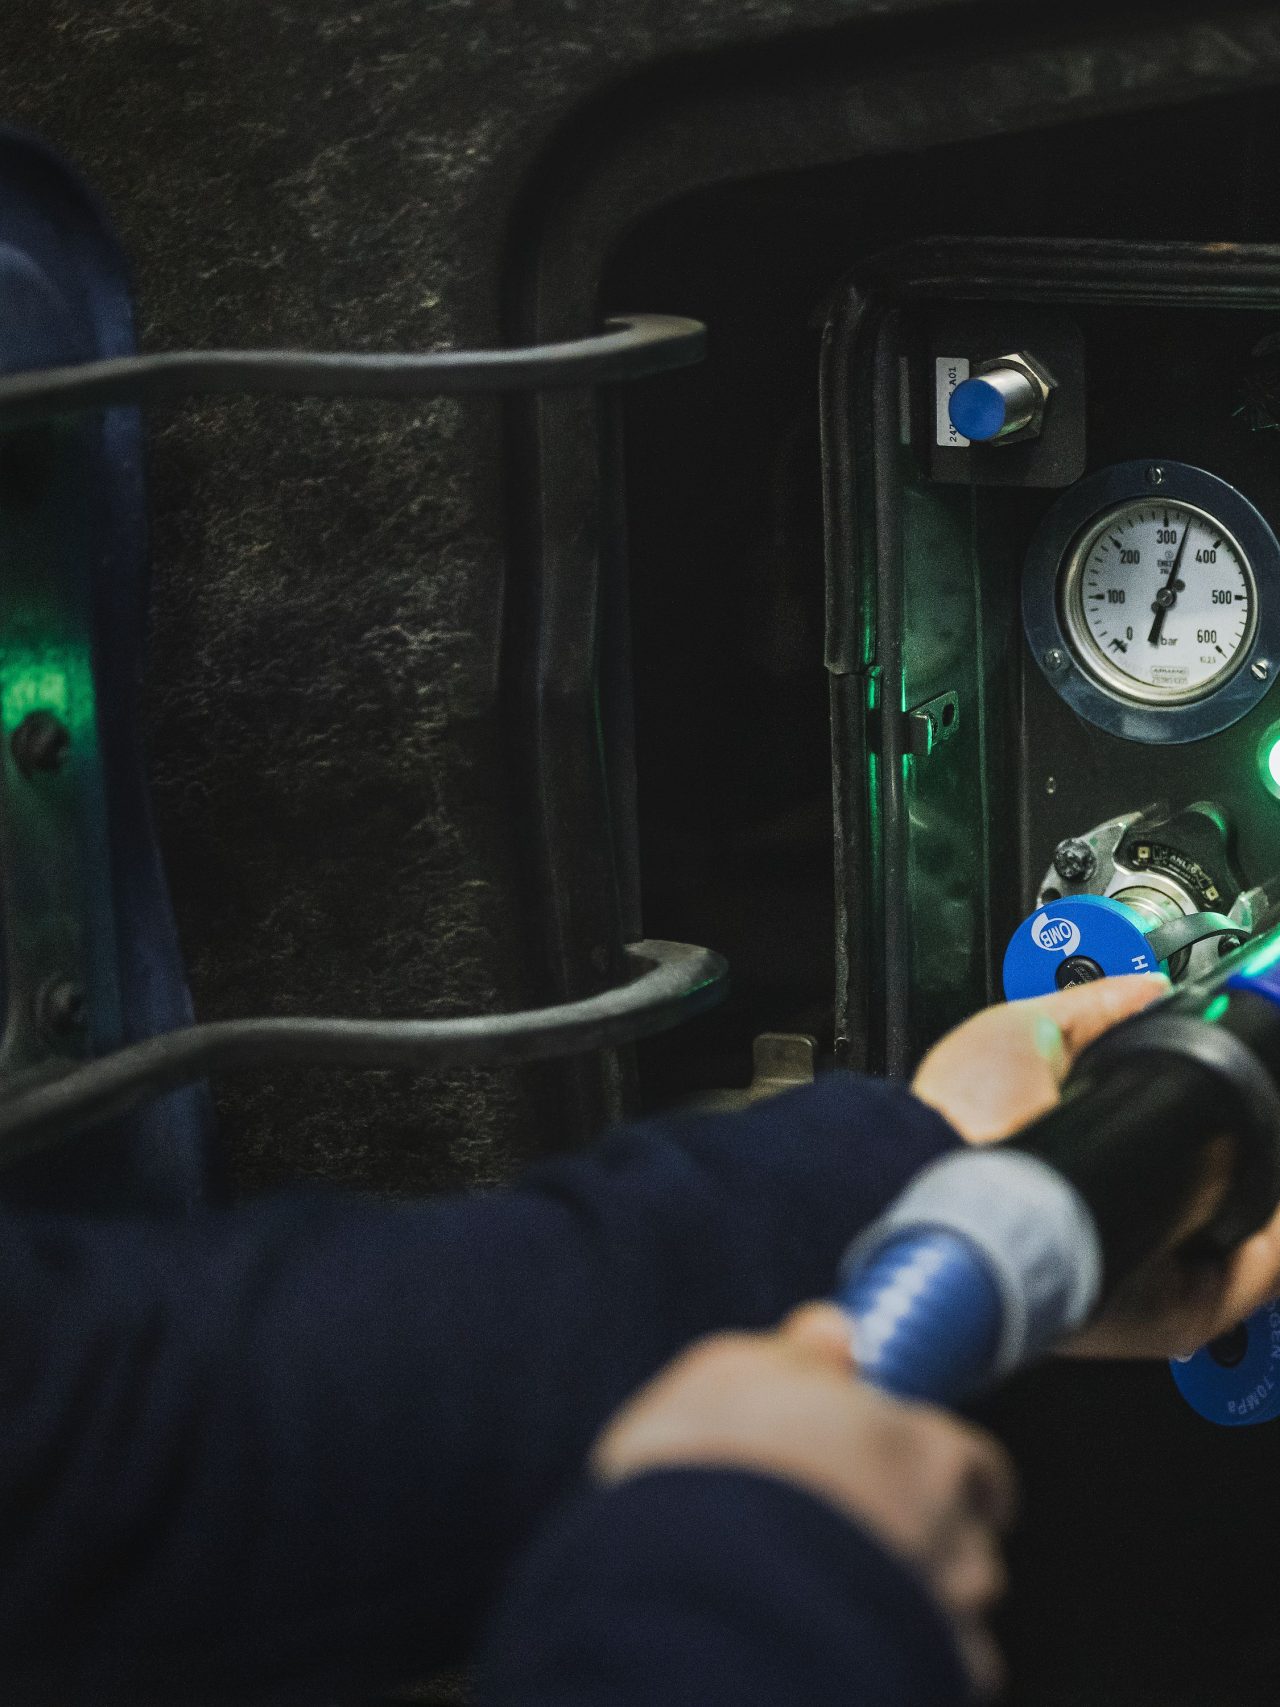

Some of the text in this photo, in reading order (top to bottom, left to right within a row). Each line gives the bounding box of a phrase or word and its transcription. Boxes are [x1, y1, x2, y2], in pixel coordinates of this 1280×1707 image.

[948, 367, 957, 386] A01
[1156, 529, 1177, 545] 300
[1120, 549, 1140, 565] 200
[1195, 549, 1216, 565] 400
[1108, 590, 1125, 605] 100
[1212, 590, 1232, 605] 500
[1126, 626, 1133, 641] 0
[1197, 629, 1217, 644] 600
[1160, 635, 1179, 648] bar
[1040, 922, 1073, 948] OMB
